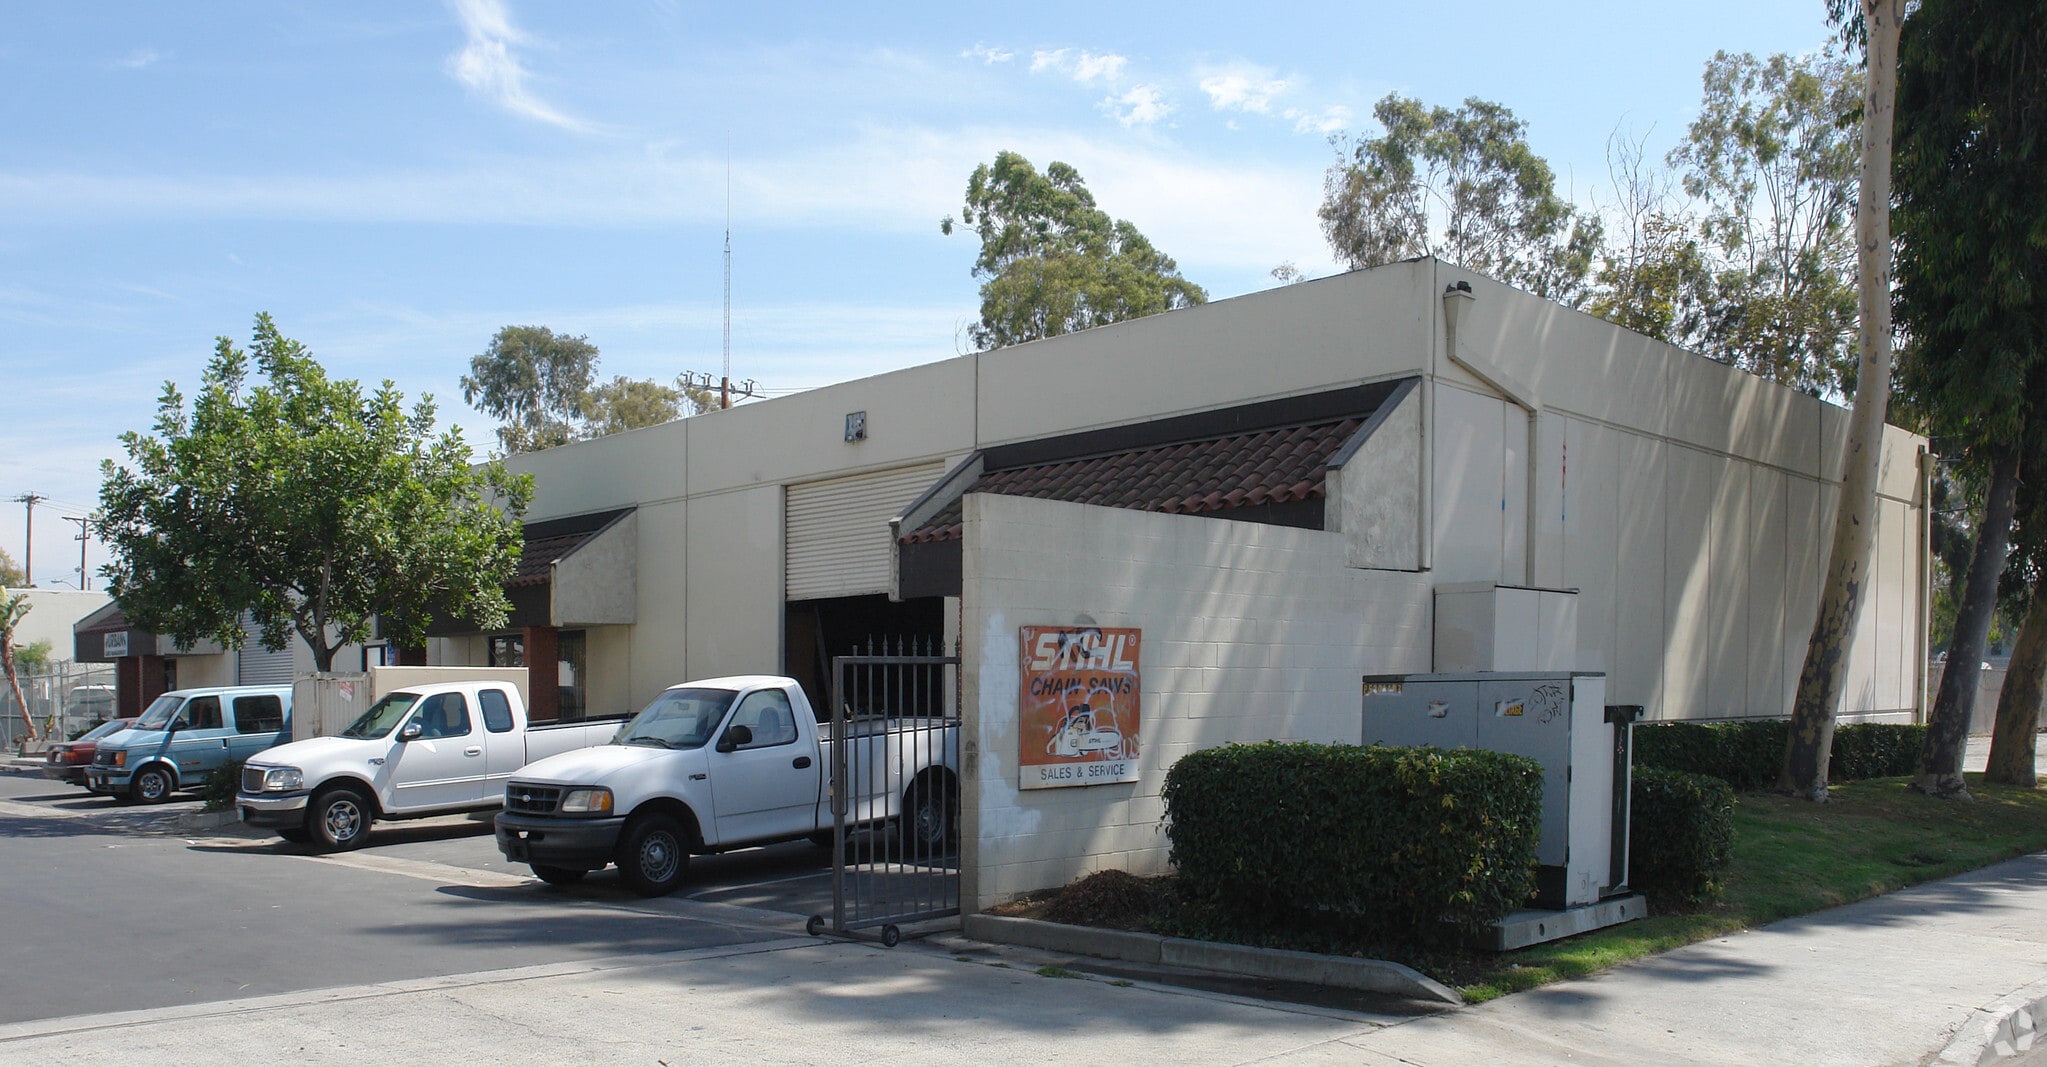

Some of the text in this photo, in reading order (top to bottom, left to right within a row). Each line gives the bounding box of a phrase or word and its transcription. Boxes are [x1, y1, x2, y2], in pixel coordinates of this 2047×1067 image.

[1031, 632, 1133, 670] STIHL
[1030, 677, 1131, 695] CHAIN SAWS
[1040, 763, 1125, 780] SALES & SERVICE
